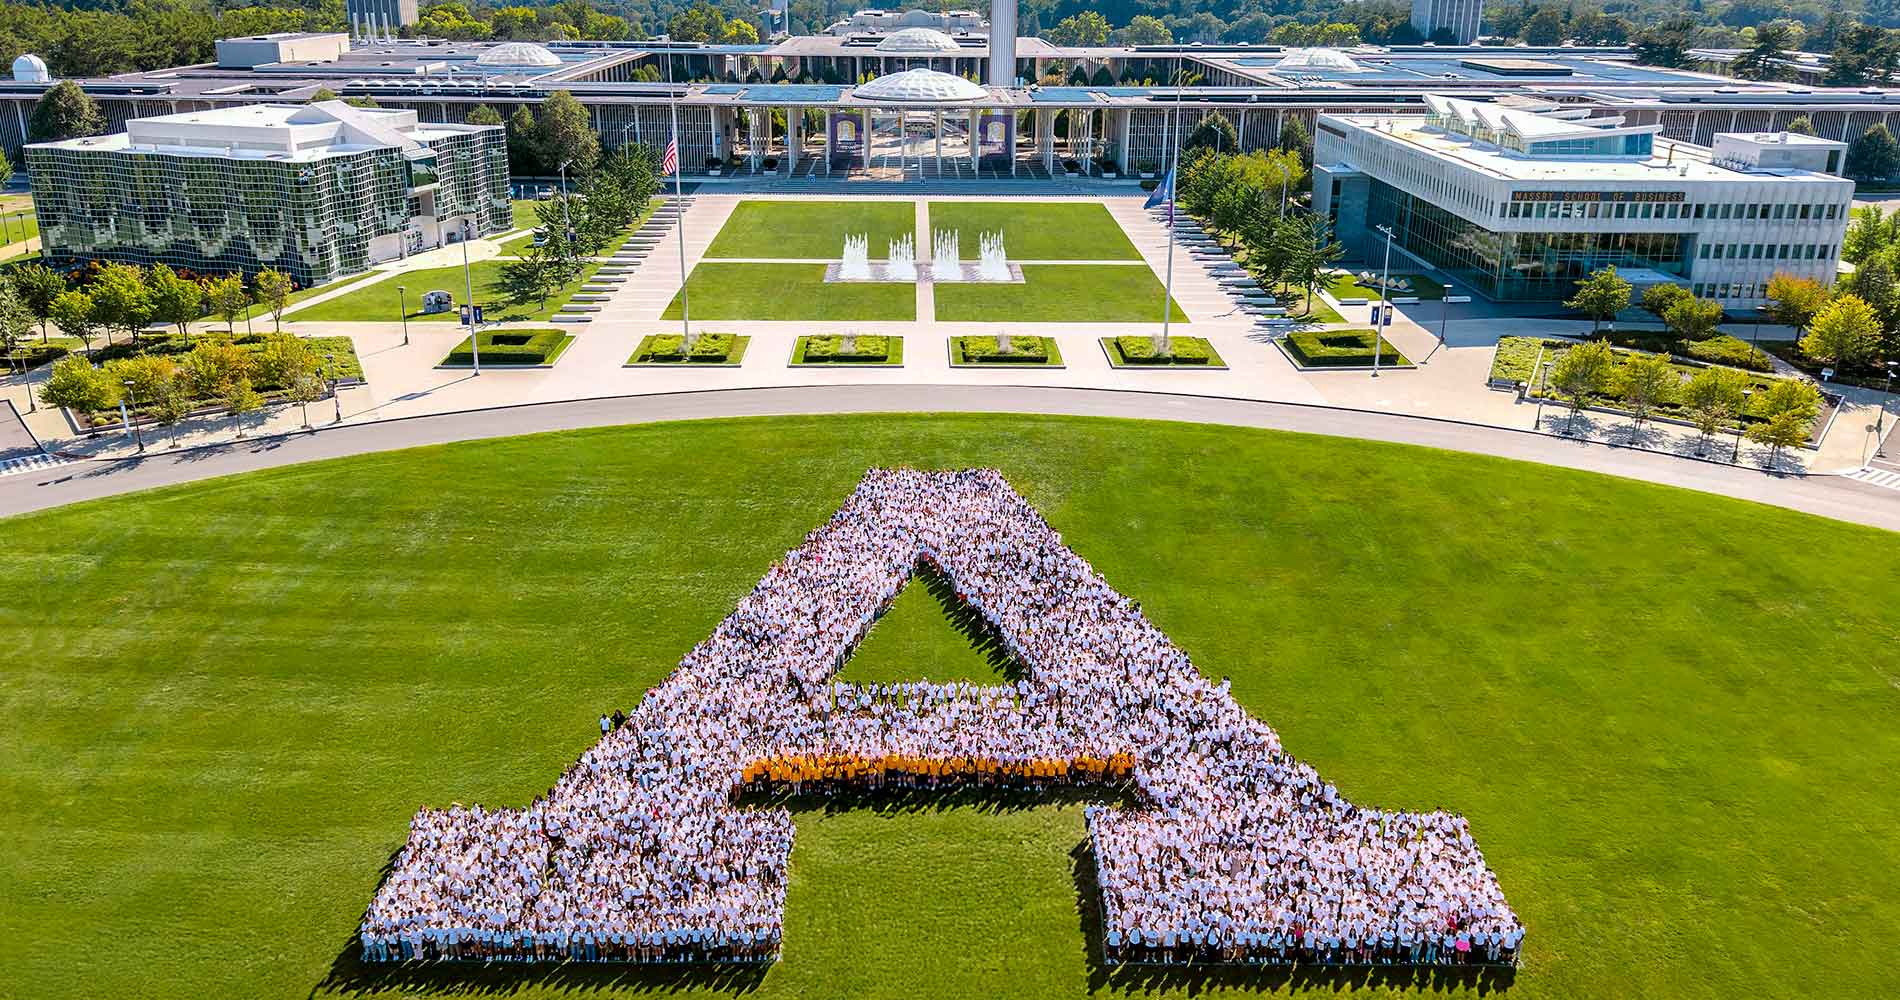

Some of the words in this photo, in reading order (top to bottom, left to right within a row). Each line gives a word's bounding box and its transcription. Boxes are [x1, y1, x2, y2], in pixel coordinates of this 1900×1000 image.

[1514, 192, 1553, 201] MASSRY
[1563, 192, 1601, 201] SCHOOL
[1612, 192, 1625, 201] OF
[1634, 192, 1684, 201] BUSINESS
